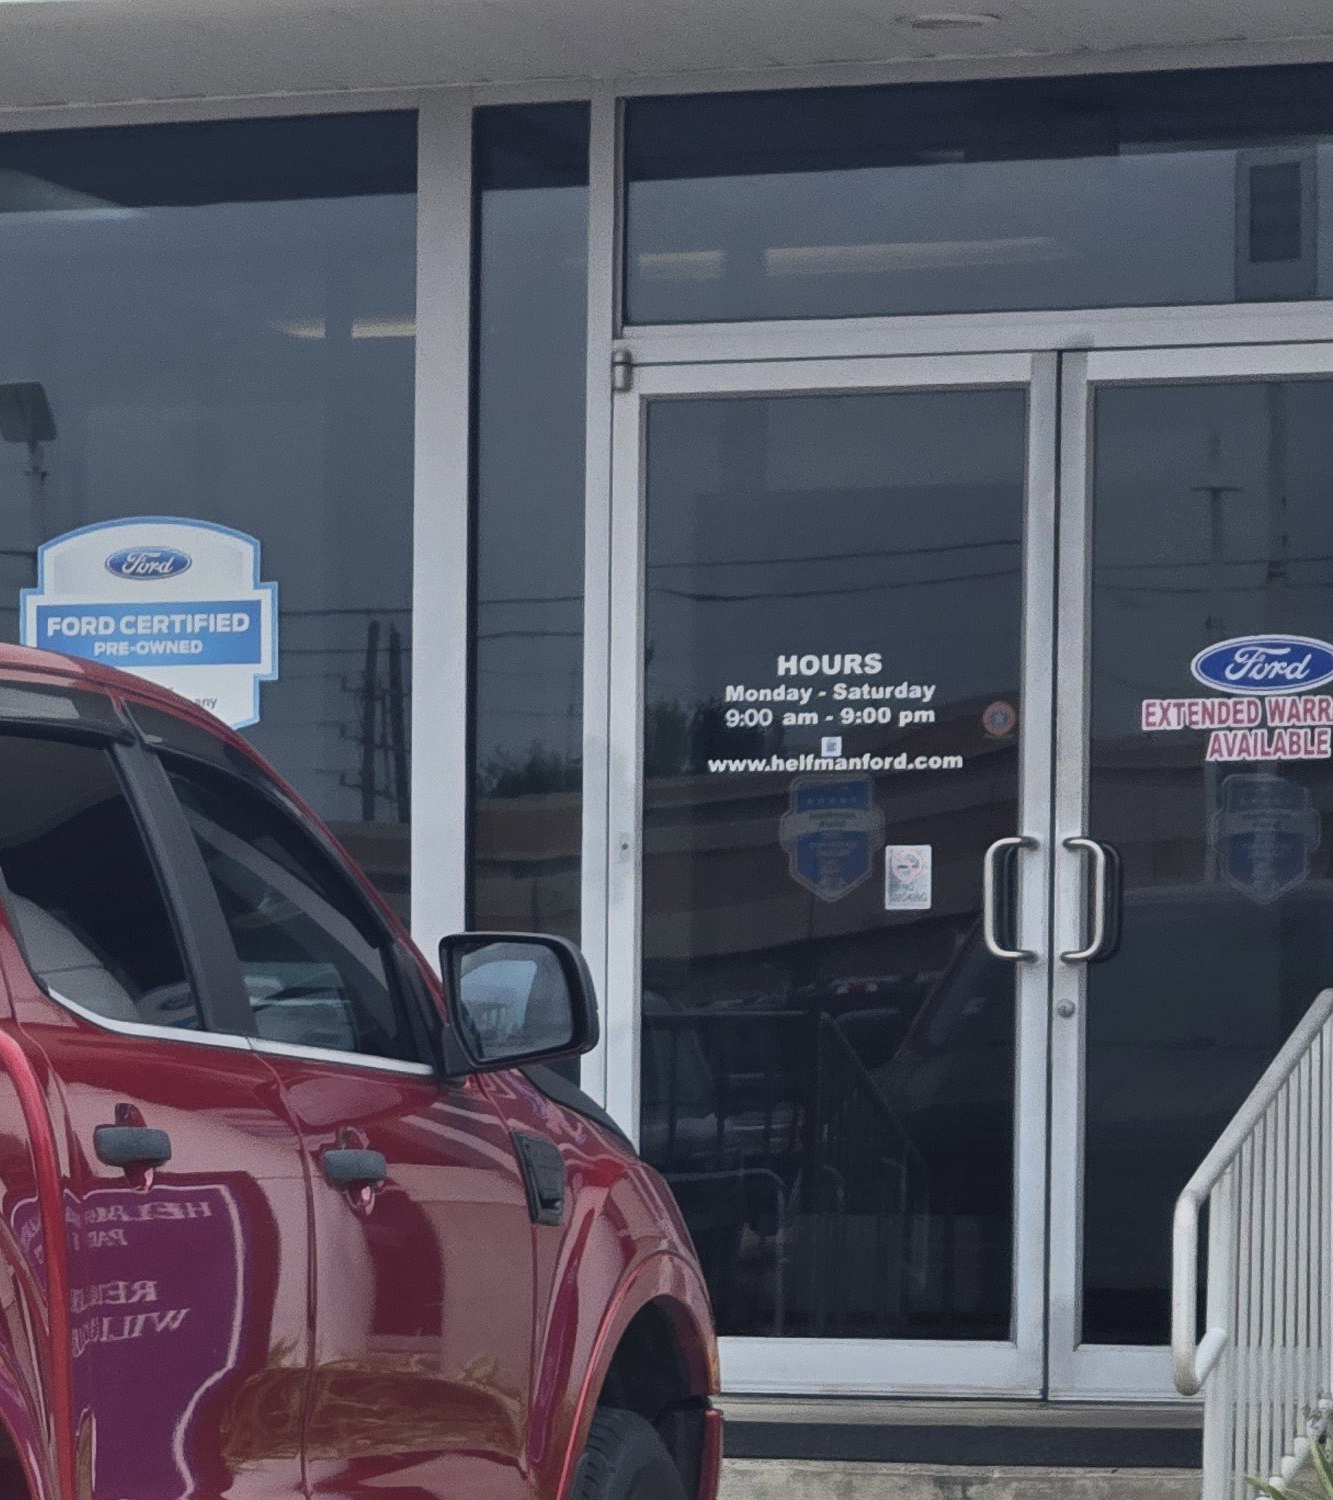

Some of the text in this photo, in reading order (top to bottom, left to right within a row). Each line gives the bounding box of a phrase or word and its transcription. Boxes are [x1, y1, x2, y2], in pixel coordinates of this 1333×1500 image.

[121, 551, 174, 575] Ford
[47, 612, 250, 637] FORD CERTIFIED
[93, 639, 203, 657] PRE-OWNED
[777, 653, 883, 676] HOURS
[1224, 646, 1313, 681] Ford
[725, 684, 813, 705] Monday
[833, 682, 936, 703] Saturday
[725, 708, 773, 727] 9:00
[783, 712, 818, 726] am
[840, 707, 891, 725] 9:00
[899, 709, 936, 727] pm
[1144, 697, 1333, 728] EXTENDED WARR
[1209, 729, 1330, 758] AVAILABLE
[707, 753, 964, 773] www.helfmanford.com
